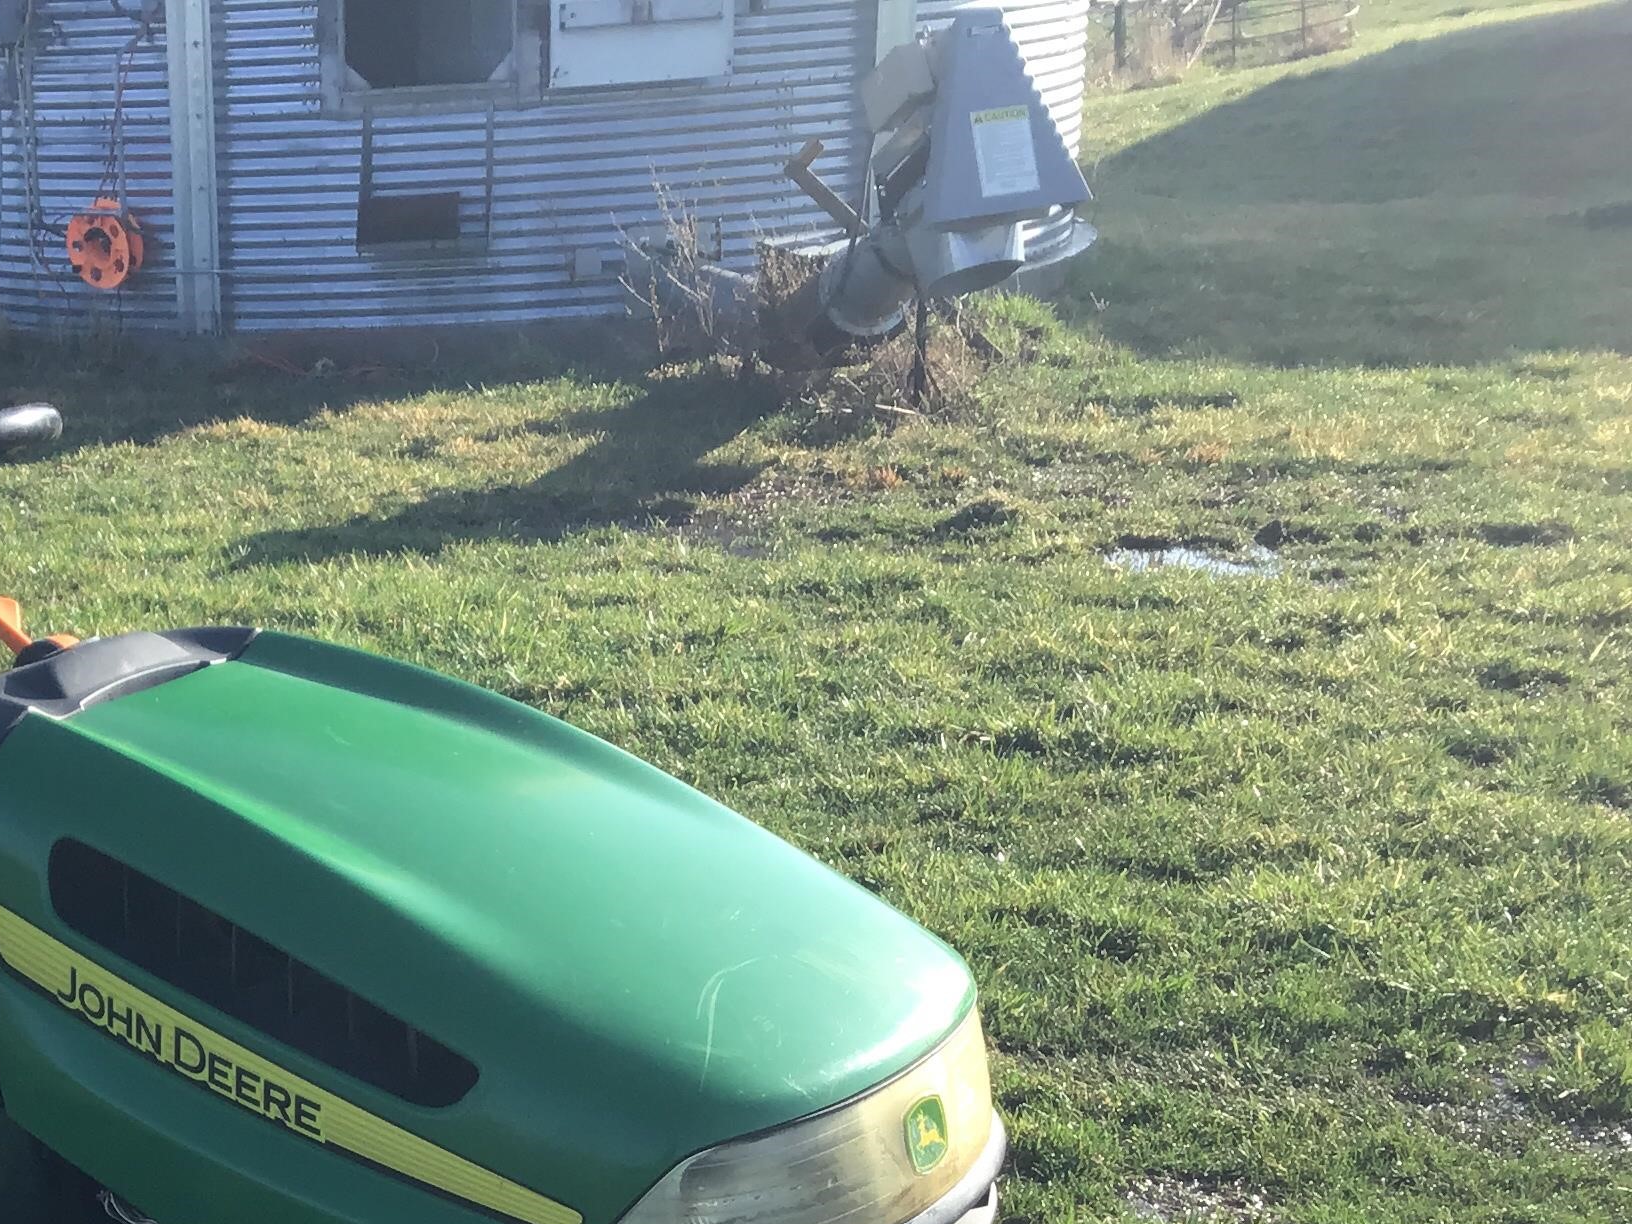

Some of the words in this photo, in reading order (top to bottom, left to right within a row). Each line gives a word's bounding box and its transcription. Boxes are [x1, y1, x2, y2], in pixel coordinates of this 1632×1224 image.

[984, 109, 1027, 121] CAUTION
[56, 967, 163, 1056] JOHN
[172, 1028, 323, 1136] DEERE
